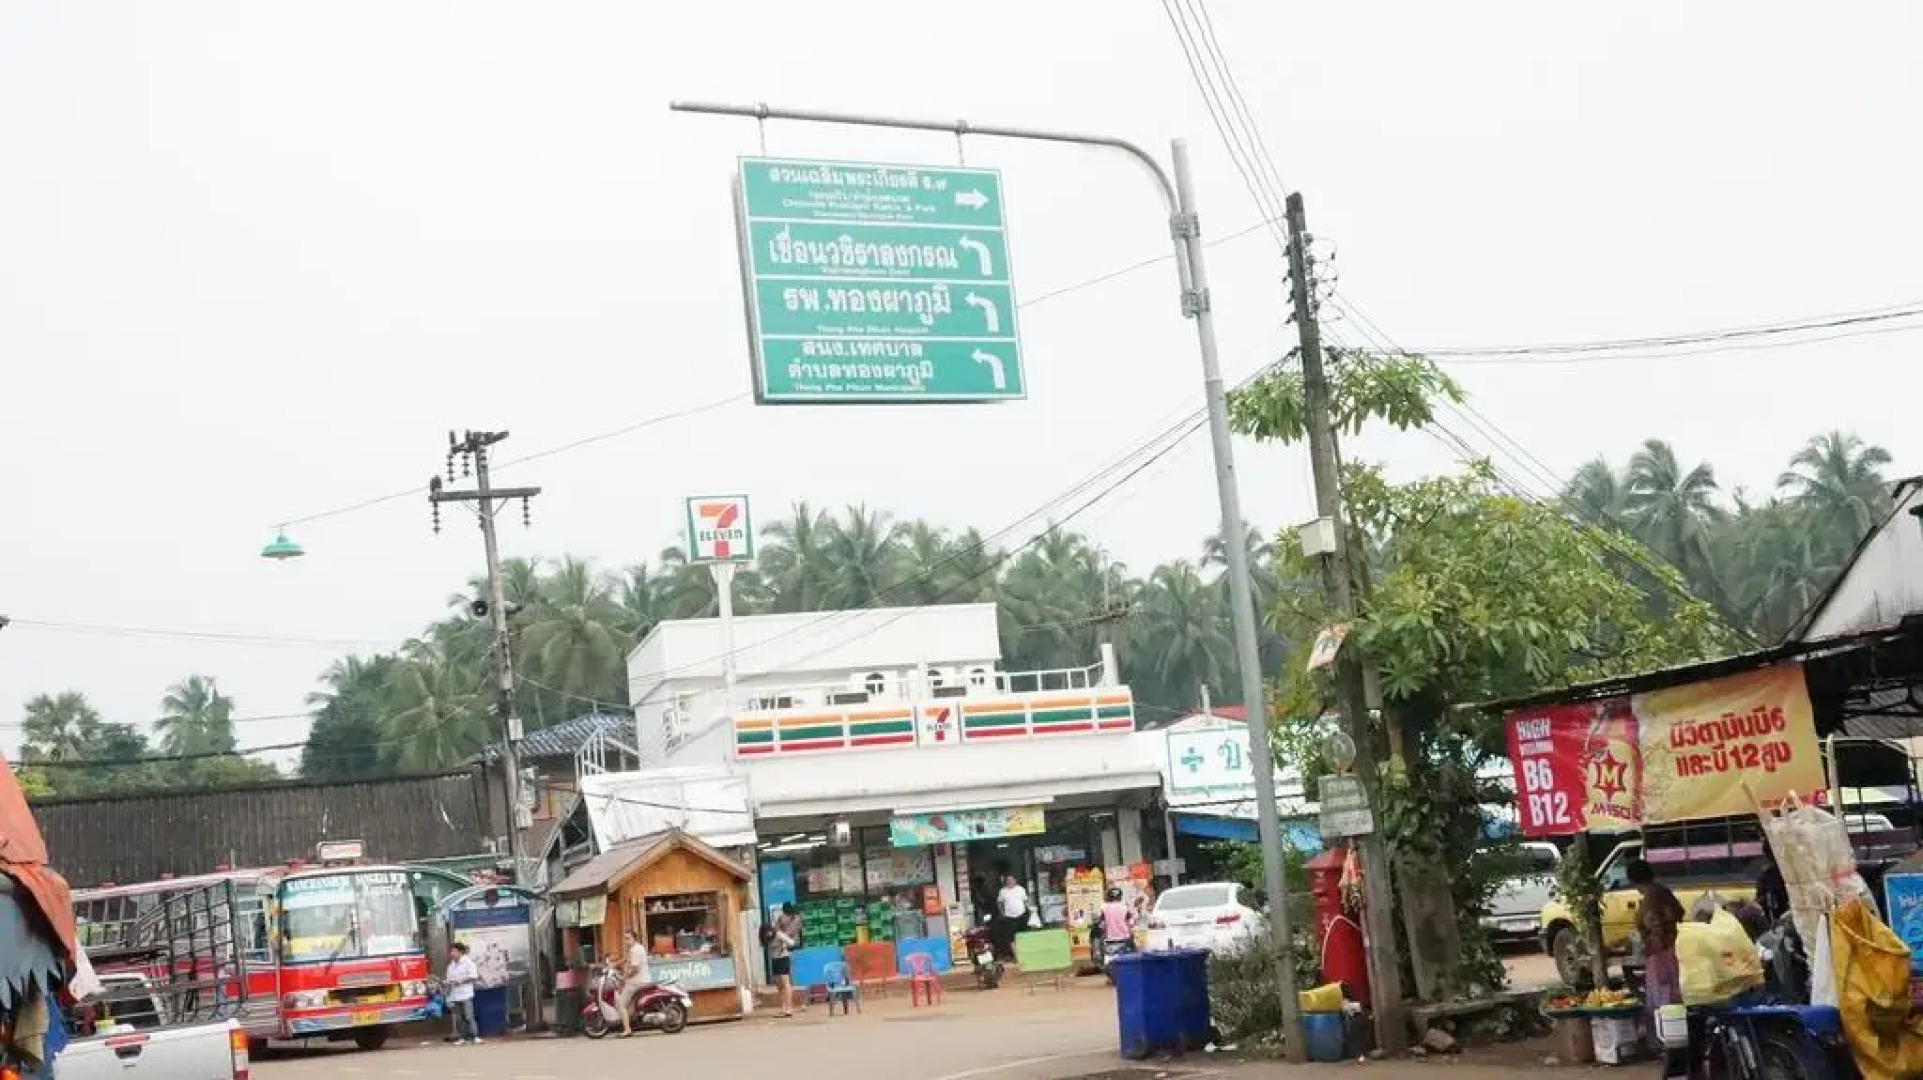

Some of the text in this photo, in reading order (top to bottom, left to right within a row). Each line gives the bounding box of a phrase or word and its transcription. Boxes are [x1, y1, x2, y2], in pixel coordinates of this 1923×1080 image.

[782, 283, 952, 326] รพ.ทองผาภูมิ
[801, 341, 923, 357] สนง.เทศบาล
[1670, 705, 1786, 749] มีวิตามินบี6
[1522, 758, 1554, 792] B6
[1528, 791, 1571, 827] B12
